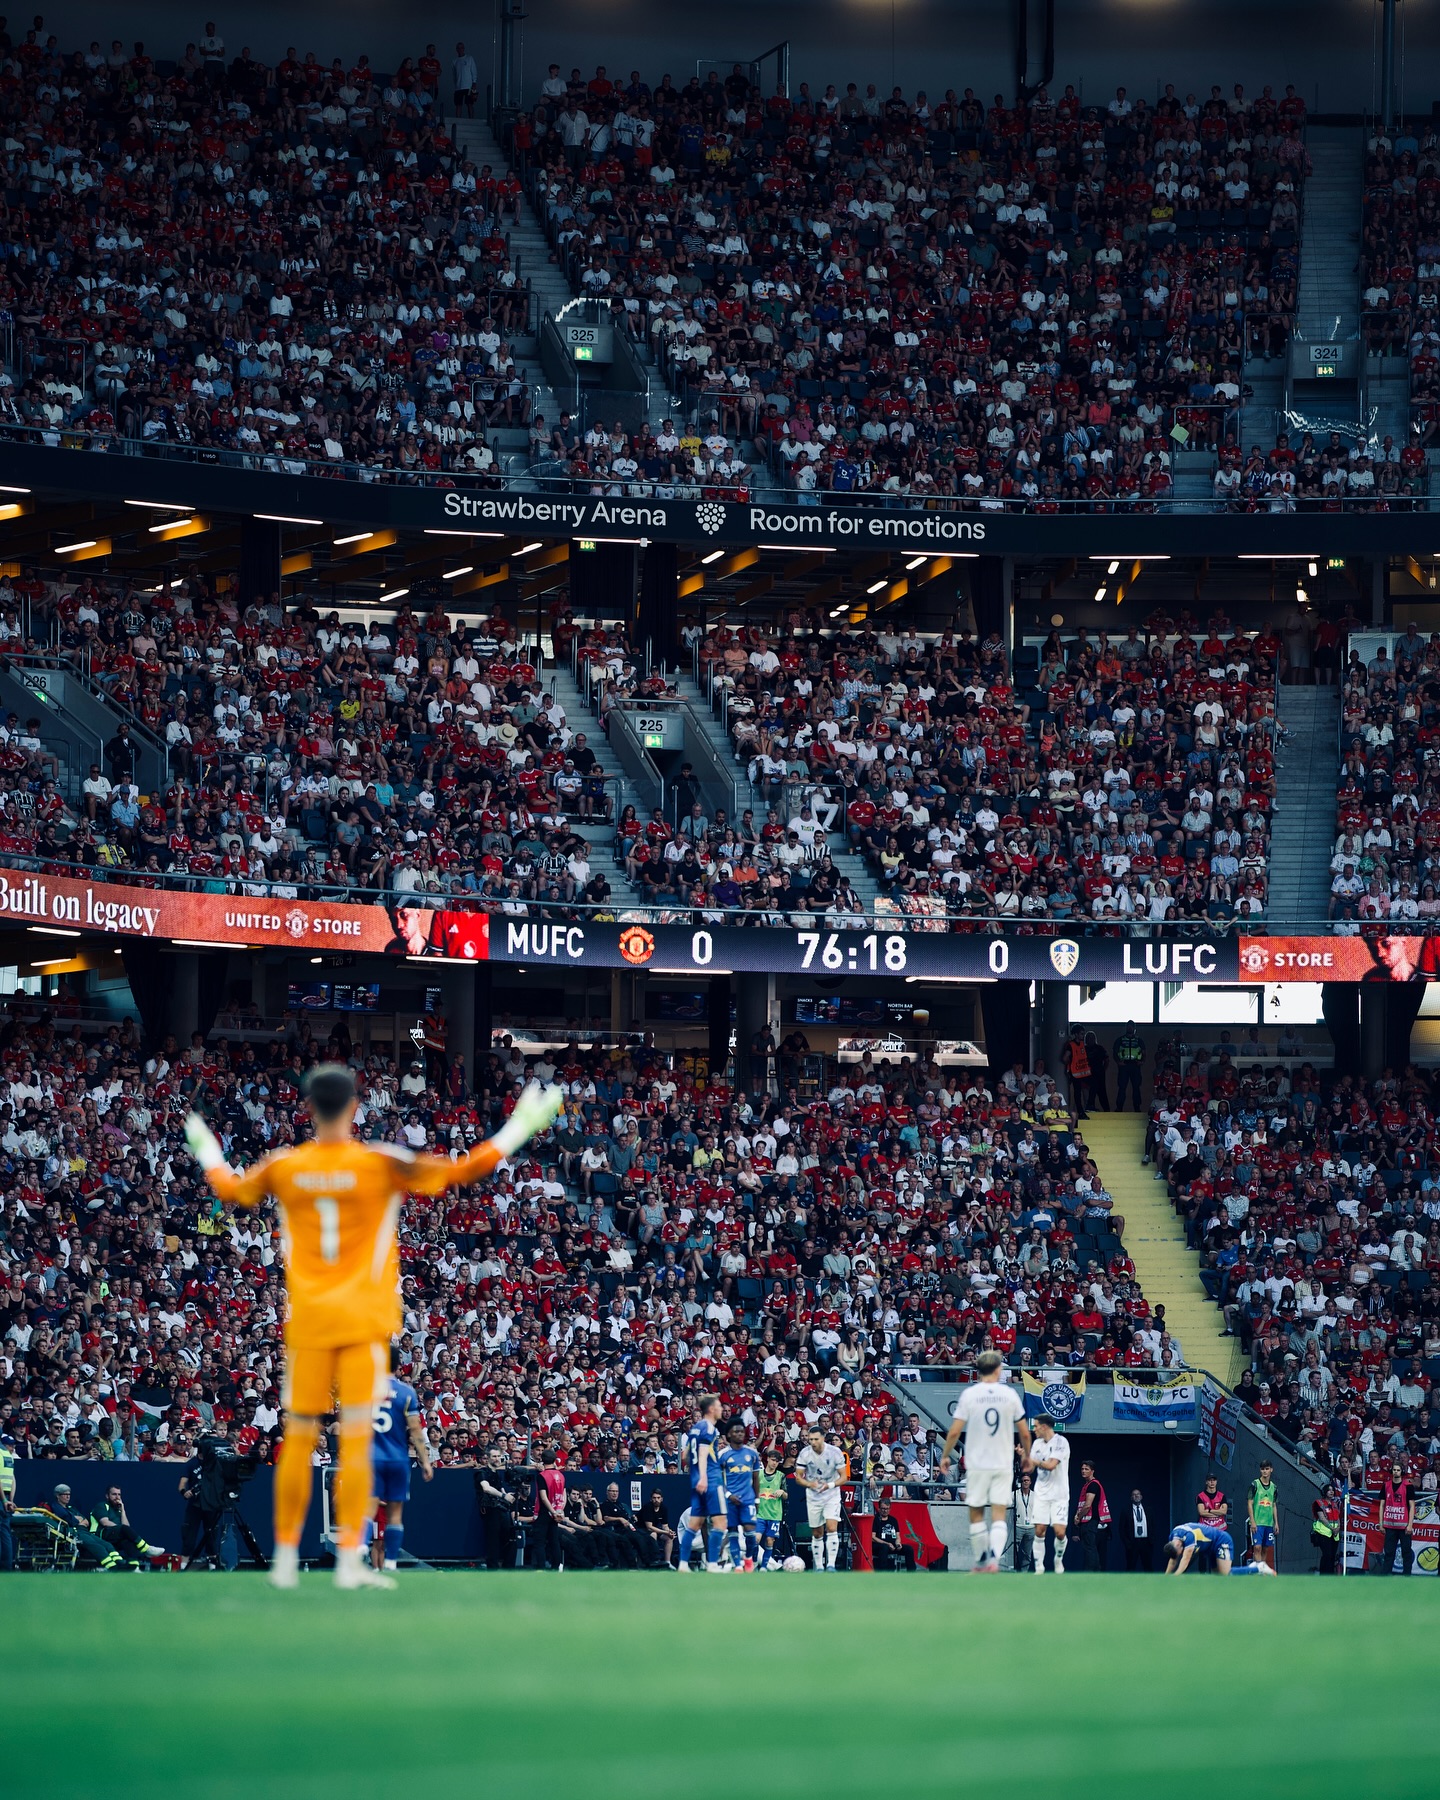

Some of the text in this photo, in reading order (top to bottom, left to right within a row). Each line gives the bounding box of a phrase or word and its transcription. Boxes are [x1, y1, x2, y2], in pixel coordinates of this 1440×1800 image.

[571, 329, 595, 342] 325
[1314, 347, 1339, 360] 324
[444, 493, 667, 528] Strawberry Arena
[750, 508, 986, 539] Room for emotions
[639, 719, 663, 732] 225
[0, 877, 161, 937] Built on legacy
[225, 911, 362, 936] UNITED STORE
[507, 922, 585, 958] MUFC
[691, 930, 713, 965] 0
[797, 932, 907, 971] 76:18
[988, 939, 1009, 974] 0
[1123, 943, 1217, 974] LUFC
[1274, 952, 1334, 967] STORE
[313, 1195, 340, 1265] 1
[1122, 1386, 1140, 1399] LU
[1172, 1387, 1189, 1400] FC
[1048, 1405, 1071, 1417] DALLAS
[1148, 1409, 1160, 1417] On
[1162, 1408, 1195, 1417] Together
[983, 1407, 1001, 1437] 9
[844, 1491, 854, 1503] 27
[1385, 1512, 1405, 1520] SAFETY
